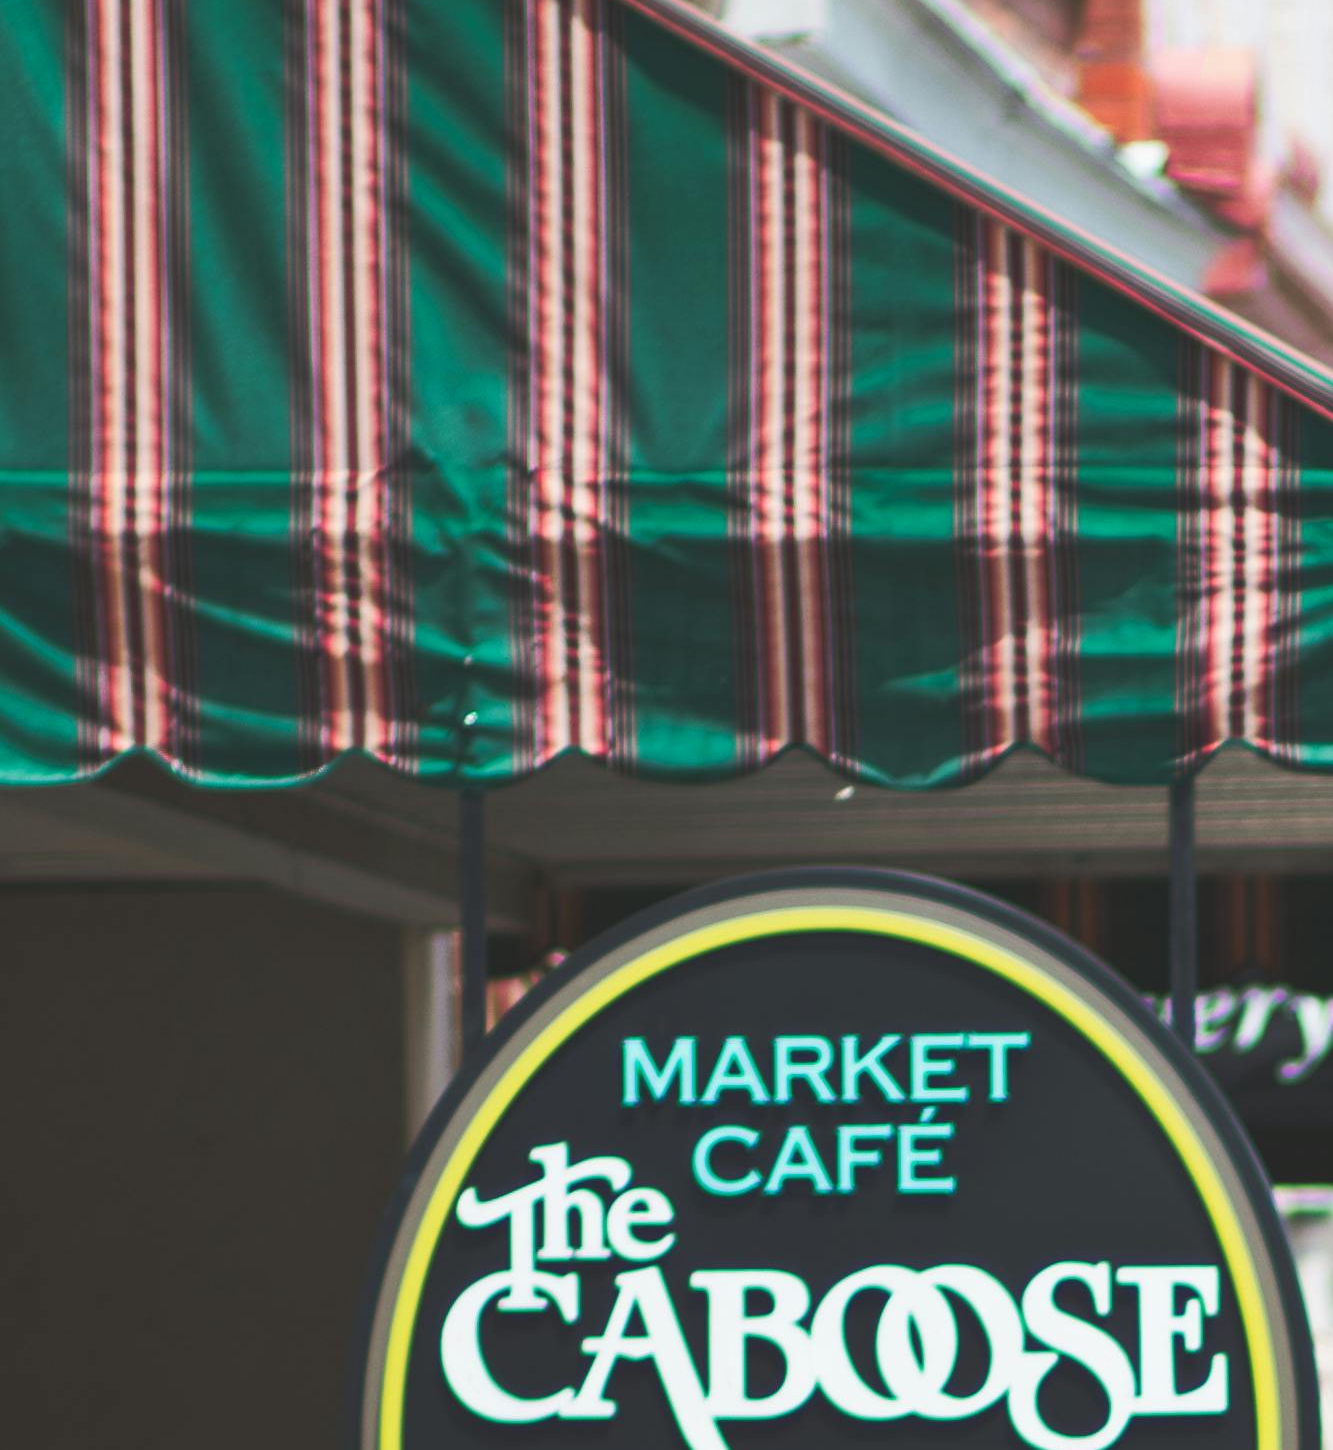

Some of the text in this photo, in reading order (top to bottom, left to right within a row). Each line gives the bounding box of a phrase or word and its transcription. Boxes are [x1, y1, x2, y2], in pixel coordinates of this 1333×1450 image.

[622, 1032, 1029, 1105] MARKET
[693, 1109, 955, 1195] CAFÉ
[456, 1143, 676, 1311] The
